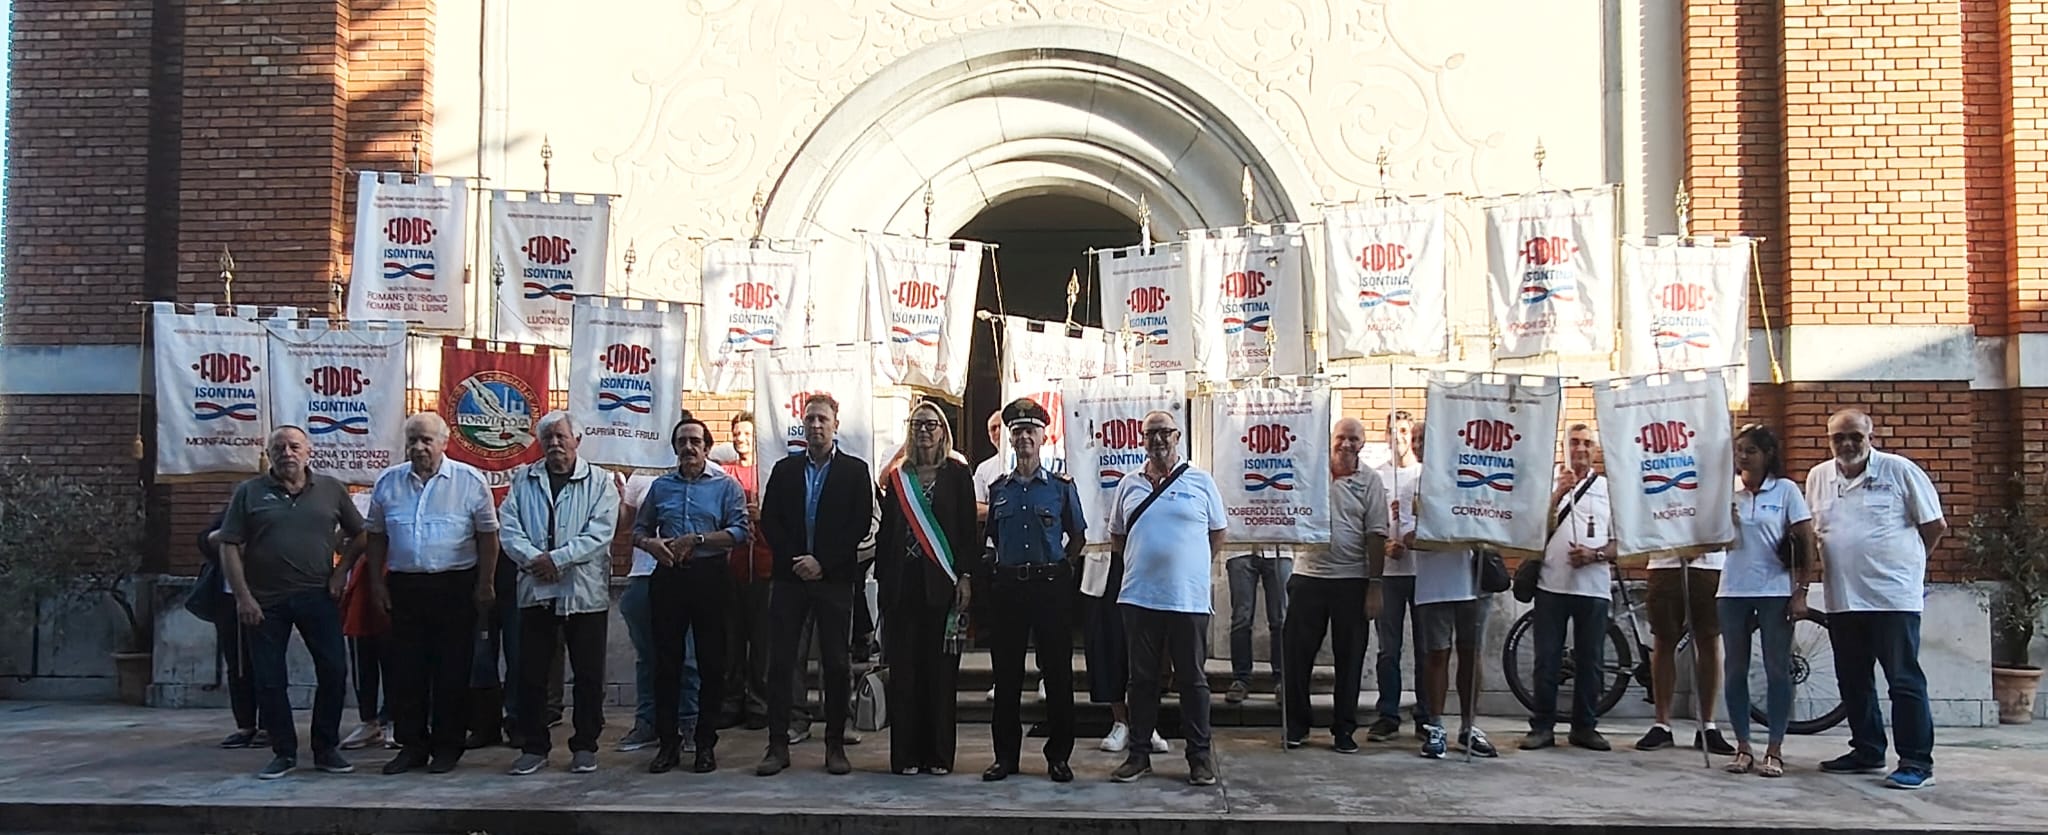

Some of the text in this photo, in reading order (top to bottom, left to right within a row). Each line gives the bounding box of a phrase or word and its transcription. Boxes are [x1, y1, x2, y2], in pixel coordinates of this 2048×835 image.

[388, 217, 432, 245] FIDAS
[384, 248, 434, 260] ISONTINA
[528, 235, 571, 265] FIDAS
[1362, 243, 1405, 272] FIDAS
[1526, 236, 1569, 266] FIDAS
[523, 267, 573, 280] ISONTINA
[1359, 273, 1410, 288] ISONTINA
[1226, 270, 1266, 299] FIDAS
[368, 290, 404, 302] ROMANS
[735, 282, 774, 310] FIDAS
[898, 280, 940, 310] FIDAS
[1131, 286, 1166, 313] FIDAS
[1662, 282, 1706, 312] FIDAS
[1222, 301, 1270, 314] ISONTINA
[526, 315, 570, 326] LUCINICO
[729, 312, 775, 326] ISONTINA
[892, 311, 939, 325] ISONTINA
[1130, 316, 1168, 328] ISONTINA
[1660, 316, 1710, 327] SONTINA
[606, 343, 652, 375] FIDAS
[1149, 360, 1182, 369] CORONA
[199, 353, 252, 383] FIDAS
[312, 365, 363, 397] FIDAS
[600, 377, 652, 392] ISONTINA
[195, 386, 256, 399] ISONTINA
[308, 400, 368, 413] ISONTINA
[584, 426, 660, 441] CAPRIVA DEL FRIULI
[1249, 424, 1290, 454] FIDAS
[1465, 419, 1514, 452] FIDAS
[1641, 420, 1688, 454] FIDAS
[185, 436, 265, 447] MONFALCONE
[341, 449, 390, 460] D'ISONZO
[1458, 453, 1515, 469] ISONTINA
[1244, 458, 1293, 470] ISONTINA
[1641, 455, 1696, 472] ISONTINA
[1270, 506, 1286, 516] DEL
[1287, 506, 1313, 516] LAGO
[1451, 505, 1513, 520] CORMONS
[1653, 507, 1697, 520] MORARO
[1244, 516, 1296, 526] DOBERDOB
